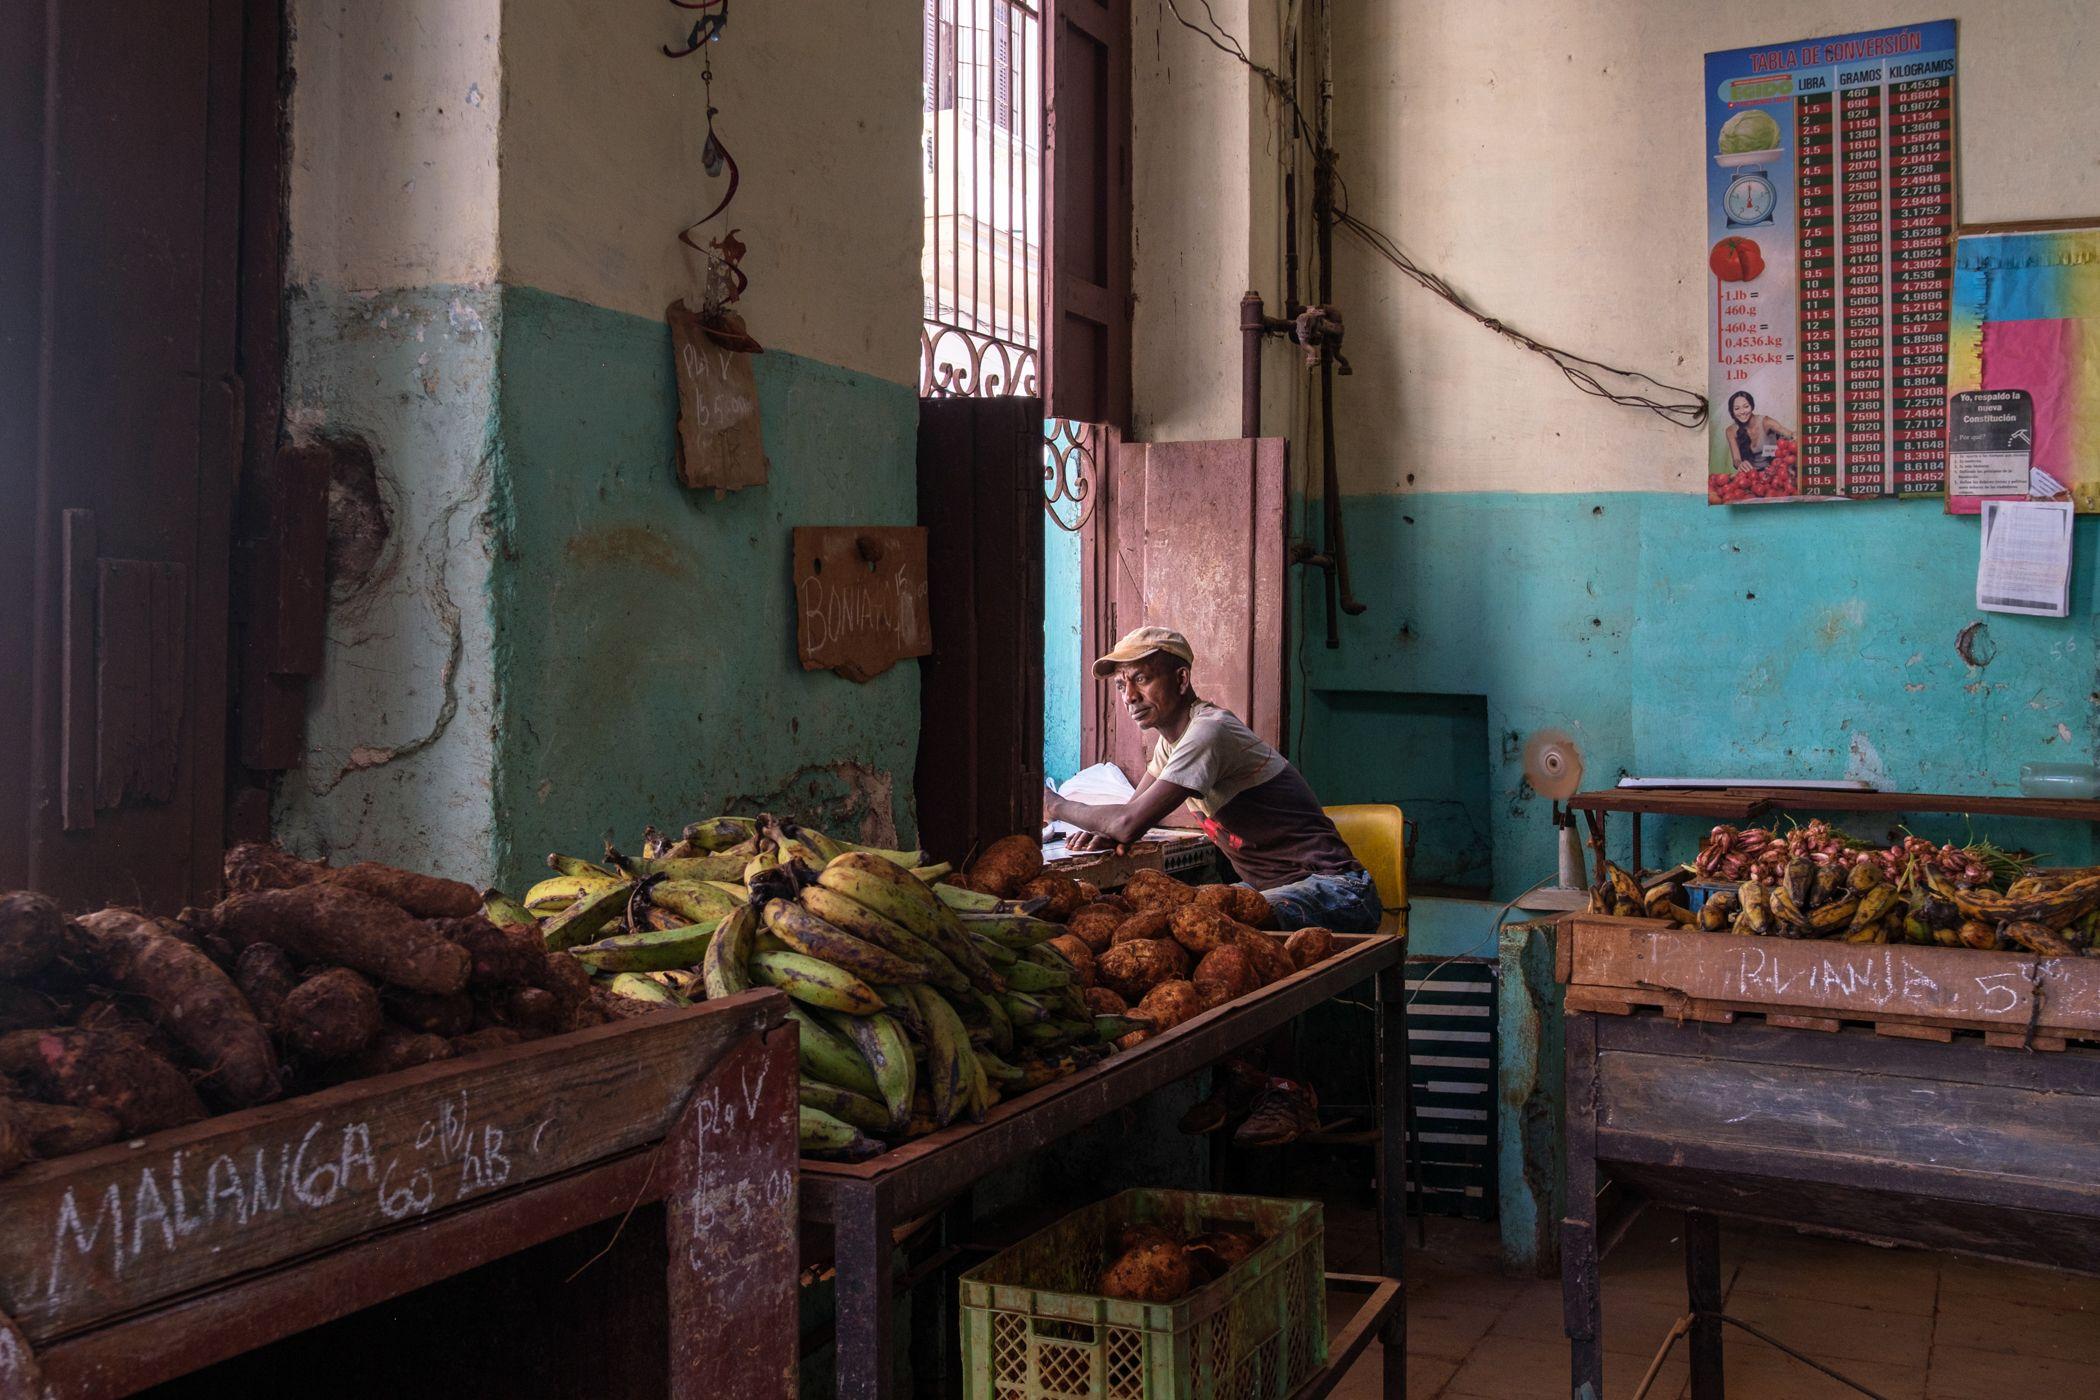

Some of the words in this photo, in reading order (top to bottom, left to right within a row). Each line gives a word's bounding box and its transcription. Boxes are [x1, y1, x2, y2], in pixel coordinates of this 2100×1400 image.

[1750, 49, 1797, 73] TABLA
[1802, 47, 1820, 65] DE
[1825, 28, 1922, 63] CONVERSIÓN
[1798, 75, 1826, 91] LIBRA
[1840, 67, 1882, 86] GRAMOS
[1889, 57, 1954, 79] KILOGRAMOS
[1803, 95, 1808, 104] 1
[1847, 88, 1868, 99] 460
[1804, 104, 1820, 115] 1.5
[1847, 98, 1868, 109] 690
[1803, 115, 1810, 124] 2
[1847, 108, 1869, 119] 920
[1803, 125, 1820, 135] 2.5
[1849, 118, 1876, 130] 1150
[1803, 135, 1810, 145] 3
[1849, 128, 1876, 140] 1380
[1803, 145, 1820, 155] 3.5
[1849, 139, 1876, 150] 1610
[1803, 156, 1810, 165] 4
[1850, 149, 1876, 160] 1840
[1803, 166, 1821, 176] 4.5
[1848, 159, 1876, 171] 2070
[1803, 176, 1811, 185] 5
[1848, 170, 1877, 181] 2300
[1803, 186, 1821, 196] 5.5
[1849, 180, 1877, 192] 2530
[1803, 197, 1811, 206] 6
[1849, 191, 1877, 202] 2760
[1803, 206, 1821, 217] 6.5
[1849, 201, 1877, 212] 2990
[1804, 217, 1811, 226] 7
[1849, 212, 1877, 223] 3220
[1804, 227, 1822, 237] 7.5
[1849, 222, 1877, 233] 3450
[1804, 238, 1811, 247] 8
[1849, 233, 1877, 244] 3680
[1804, 248, 1822, 258] 8.5
[1849, 243, 1877, 254] 3910
[1804, 259, 1812, 268] 9
[1849, 254, 1878, 265] 4140
[1804, 268, 1822, 278] 9.5
[1849, 264, 1878, 275] 4370
[1806, 279, 1819, 288] 10
[1850, 275, 1878, 285] 4600
[1806, 289, 1829, 299] 10.5
[1850, 285, 1878, 296] 4830
[1806, 300, 1818, 309] 11
[1850, 296, 1878, 306] 5060
[1725, 304, 1756, 316] 460.g
[1806, 310, 1830, 320] 11.5
[1850, 306, 1878, 317] 5290
[1725, 321, 1756, 334] 460.g
[1806, 320, 1819, 330] 12
[1850, 316, 1879, 327] 5520
[1807, 330, 1830, 341] 12.5
[1850, 327, 1879, 338] 5750
[1725, 336, 1782, 348] 0.4536.kg
[1807, 341, 1820, 351] 13
[1850, 338, 1879, 348] 5980
[1725, 352, 1783, 365] 0.4536.kg
[1807, 351, 1830, 361] 13.5
[1850, 348, 1879, 358] 6210
[1807, 362, 1820, 371] 14
[1850, 358, 1879, 369] 6440
[1807, 372, 1830, 382] 14.5
[1851, 369, 1879, 379] 6670
[1807, 383, 1820, 392] 15
[1851, 379, 1879, 390] 6900
[1807, 393, 1830, 403] 15.5
[1852, 390, 1879, 400] 7130
[1960, 393, 1973, 402] Yo,
[1974, 391, 2011, 402] respaldo
[2012, 391, 2021, 400] la
[1808, 404, 1820, 413] 16
[1852, 401, 1880, 411] 7360
[1977, 404, 2003, 412] nueva
[1807, 414, 1831, 423] 16.5
[1851, 411, 1880, 421] 7590
[1963, 413, 2017, 423] Constitución
[1808, 425, 1820, 434] 17
[1852, 422, 1880, 432] 7820
[1808, 435, 1831, 444] 17.5
[1851, 432, 1880, 442] 8050
[1808, 445, 1820, 454] 18
[1852, 443, 1880, 453] 8280
[1808, 455, 1831, 465] 18.5
[1851, 453, 1880, 463] 8510
[1808, 466, 1821, 475] 19
[1852, 463, 1880, 473] 8740
[1808, 476, 1831, 485] 19.5
[1852, 474, 1880, 484] 8970
[1807, 487, 1820, 496] 20
[1851, 485, 1880, 494] 9200
